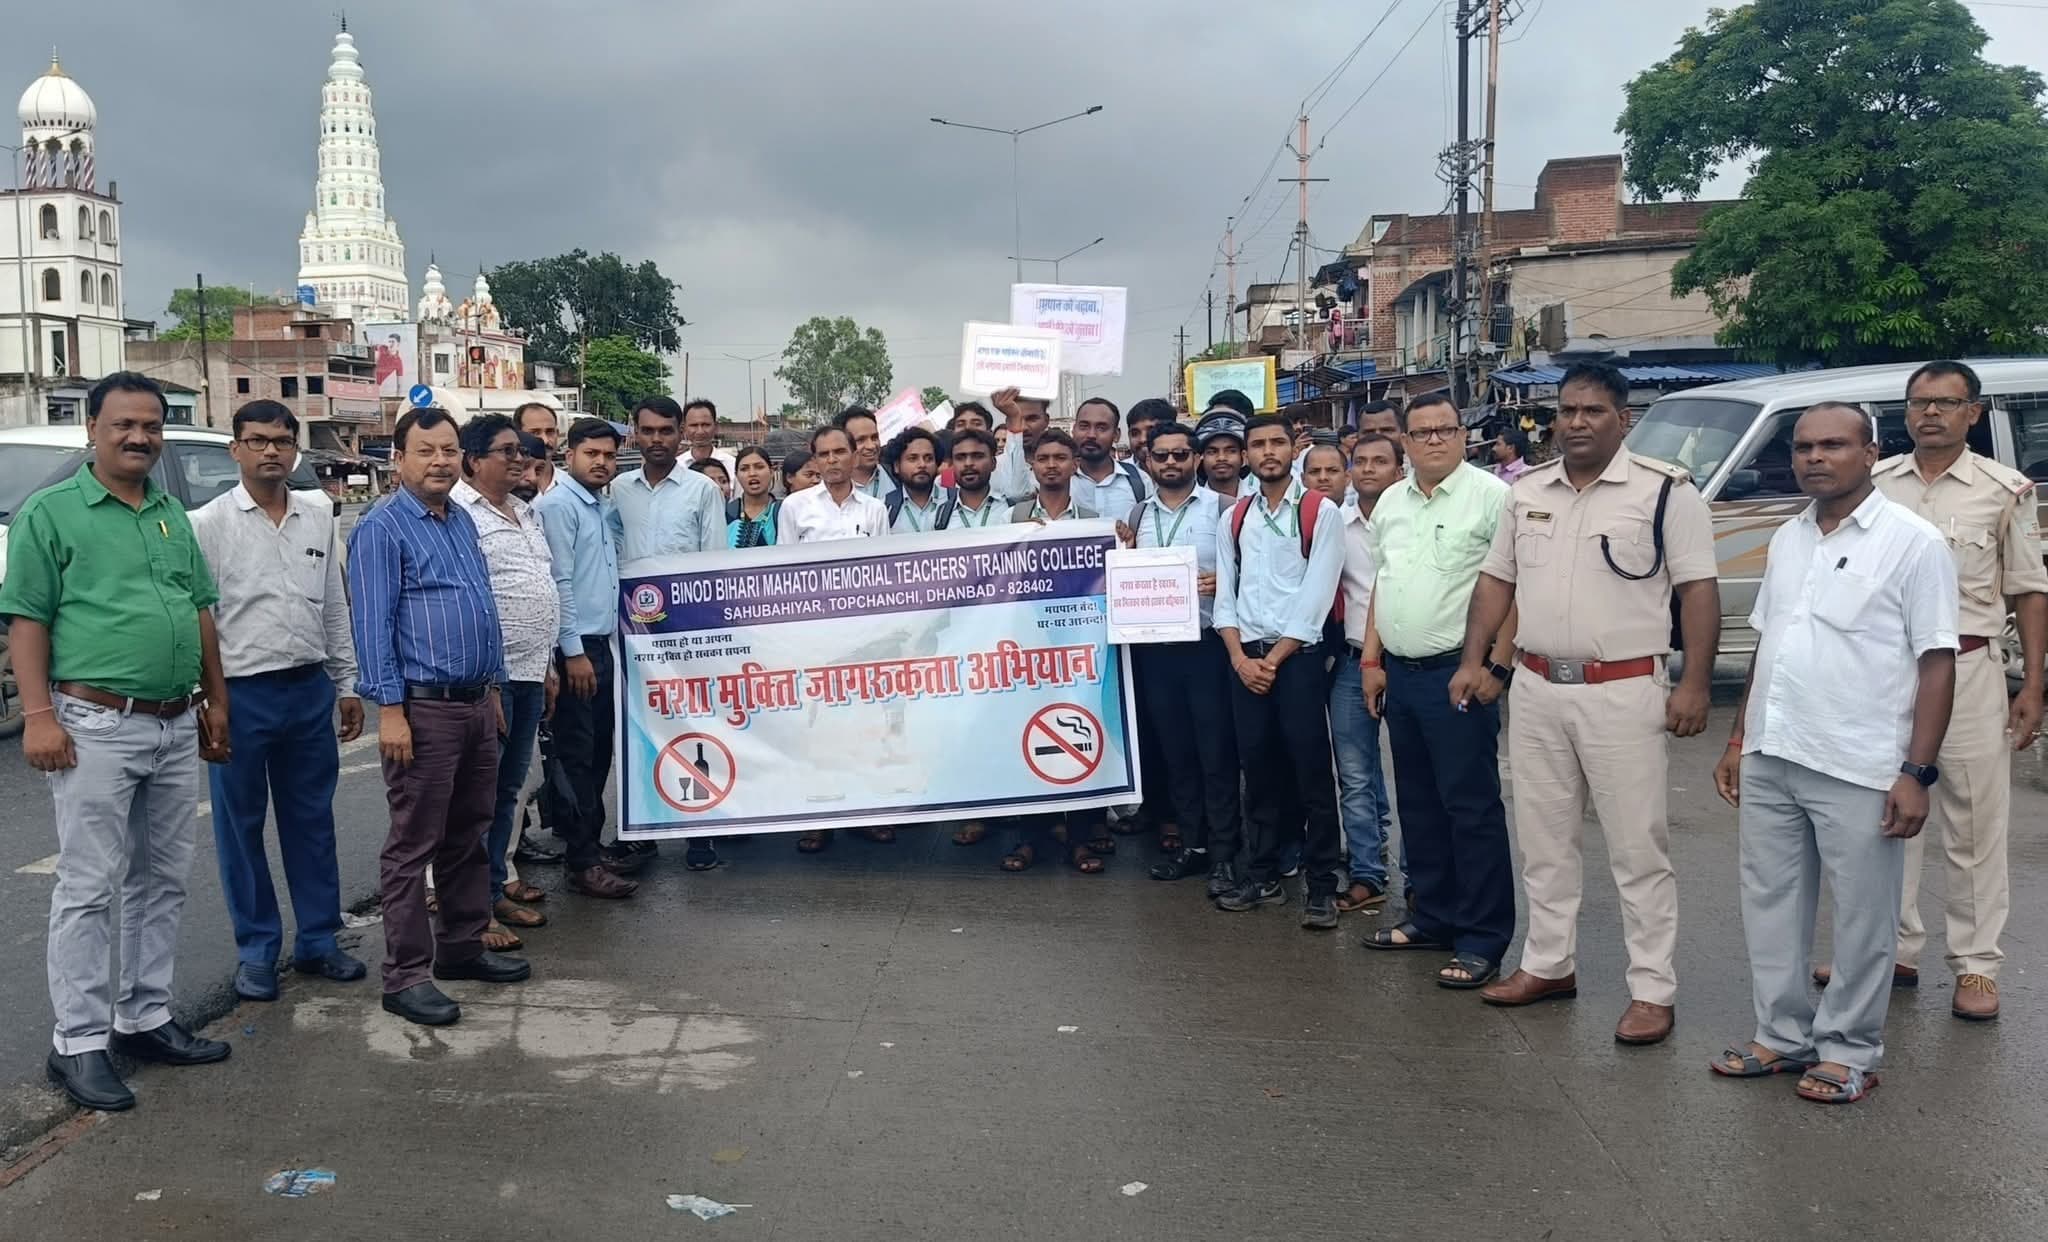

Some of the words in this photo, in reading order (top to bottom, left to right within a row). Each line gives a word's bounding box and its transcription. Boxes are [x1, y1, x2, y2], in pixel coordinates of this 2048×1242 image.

[671, 579, 712, 605] BINOD
[716, 576, 760, 601] BIHARI
[763, 571, 818, 597] MAHATO
[822, 562, 892, 591] MEMORIAL
[895, 558, 970, 584] TEACHERS'
[973, 549, 1037, 578] TRAINING
[1041, 545, 1103, 572] COLLEGE
[724, 600, 824, 621] SAHUBAHIYAR,
[829, 592, 922, 611] TOPCHANCHI,
[927, 583, 994, 603] DHANBAD
[1008, 579, 1053, 595] 828402
[679, 636, 688, 648] हो
[691, 637, 702, 645] या
[705, 633, 732, 645] अपना
[725, 645, 751, 656] सपना
[646, 676, 713, 716] नशा
[717, 661, 799, 728] मुक्ति
[967, 639, 1098, 690] अभियान
